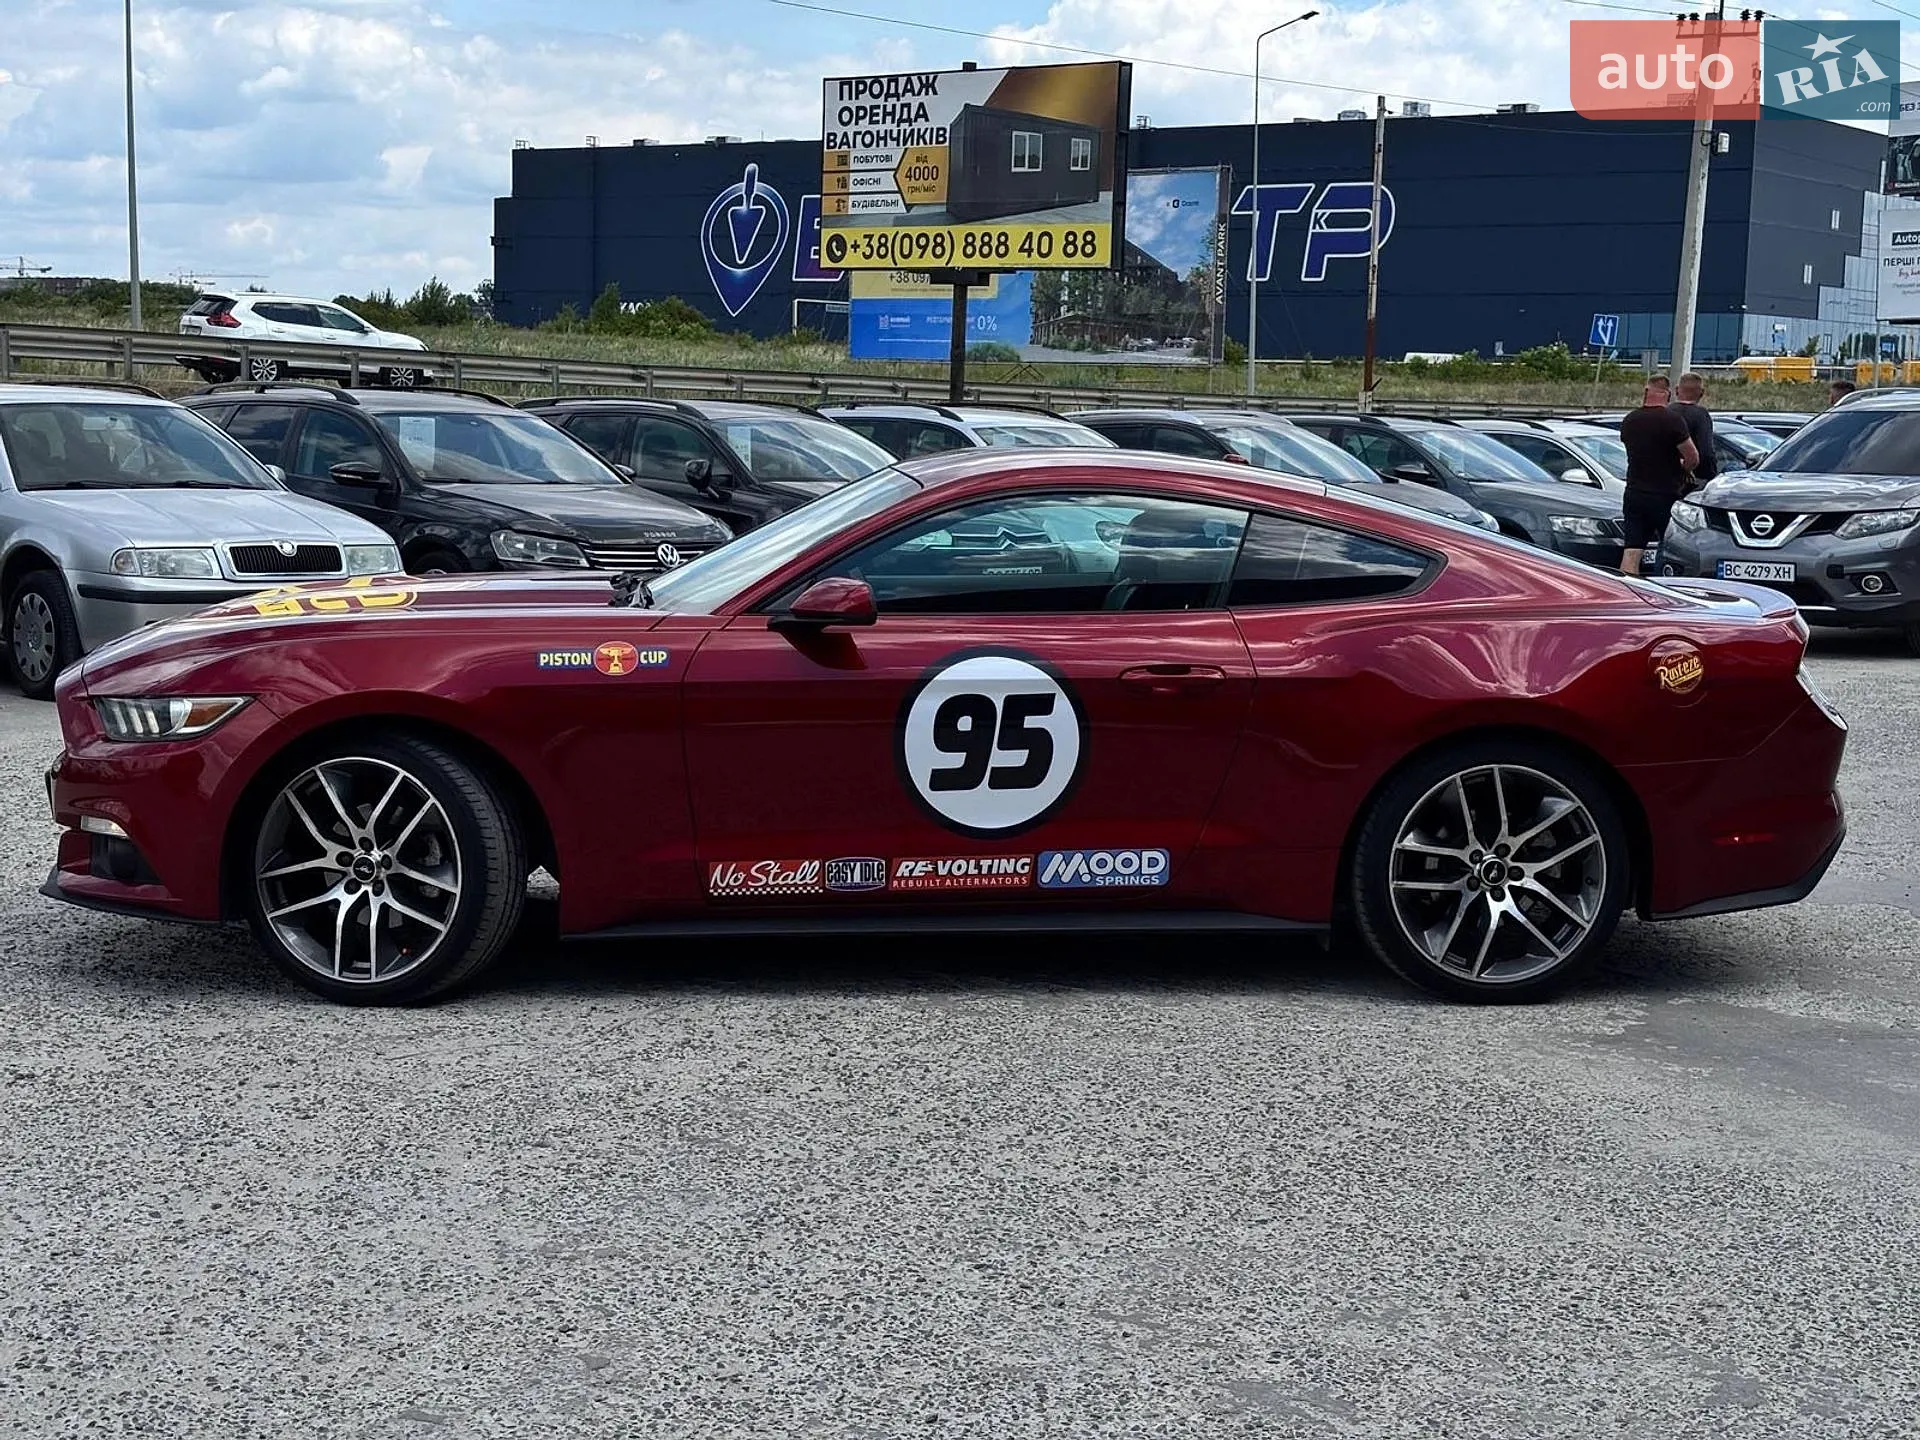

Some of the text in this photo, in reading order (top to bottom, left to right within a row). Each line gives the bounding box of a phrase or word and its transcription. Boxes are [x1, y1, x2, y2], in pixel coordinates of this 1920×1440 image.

[838, 75, 939, 102] ПРОДАЖ
[838, 102, 930, 128] ОРЕНДА
[826, 127, 948, 149] ВАГОНЧИКІВ
[853, 154, 893, 164] ПОБУТОВІ
[915, 153, 929, 164] від
[904, 165, 940, 181] 4000
[851, 177, 881, 187] ОФІСНІ
[907, 184, 937, 194] грн/міс
[851, 199, 899, 209] БУДІВЕЛЬНІ
[850, 230, 1097, 267] +38(098) 888 40 88
[1215, 223, 1227, 305] AVANT PARK
[977, 315, 998, 332] 0%
[1725, 563, 1791, 579] BC 4279 XH
[540, 650, 668, 666] PISTON CUP
[928, 692, 1057, 792] 95
[711, 859, 821, 888] No Stall
[892, 875, 1028, 888] REBUILT ALTERNATORS
[1095, 874, 1160, 887] SPRINGS
